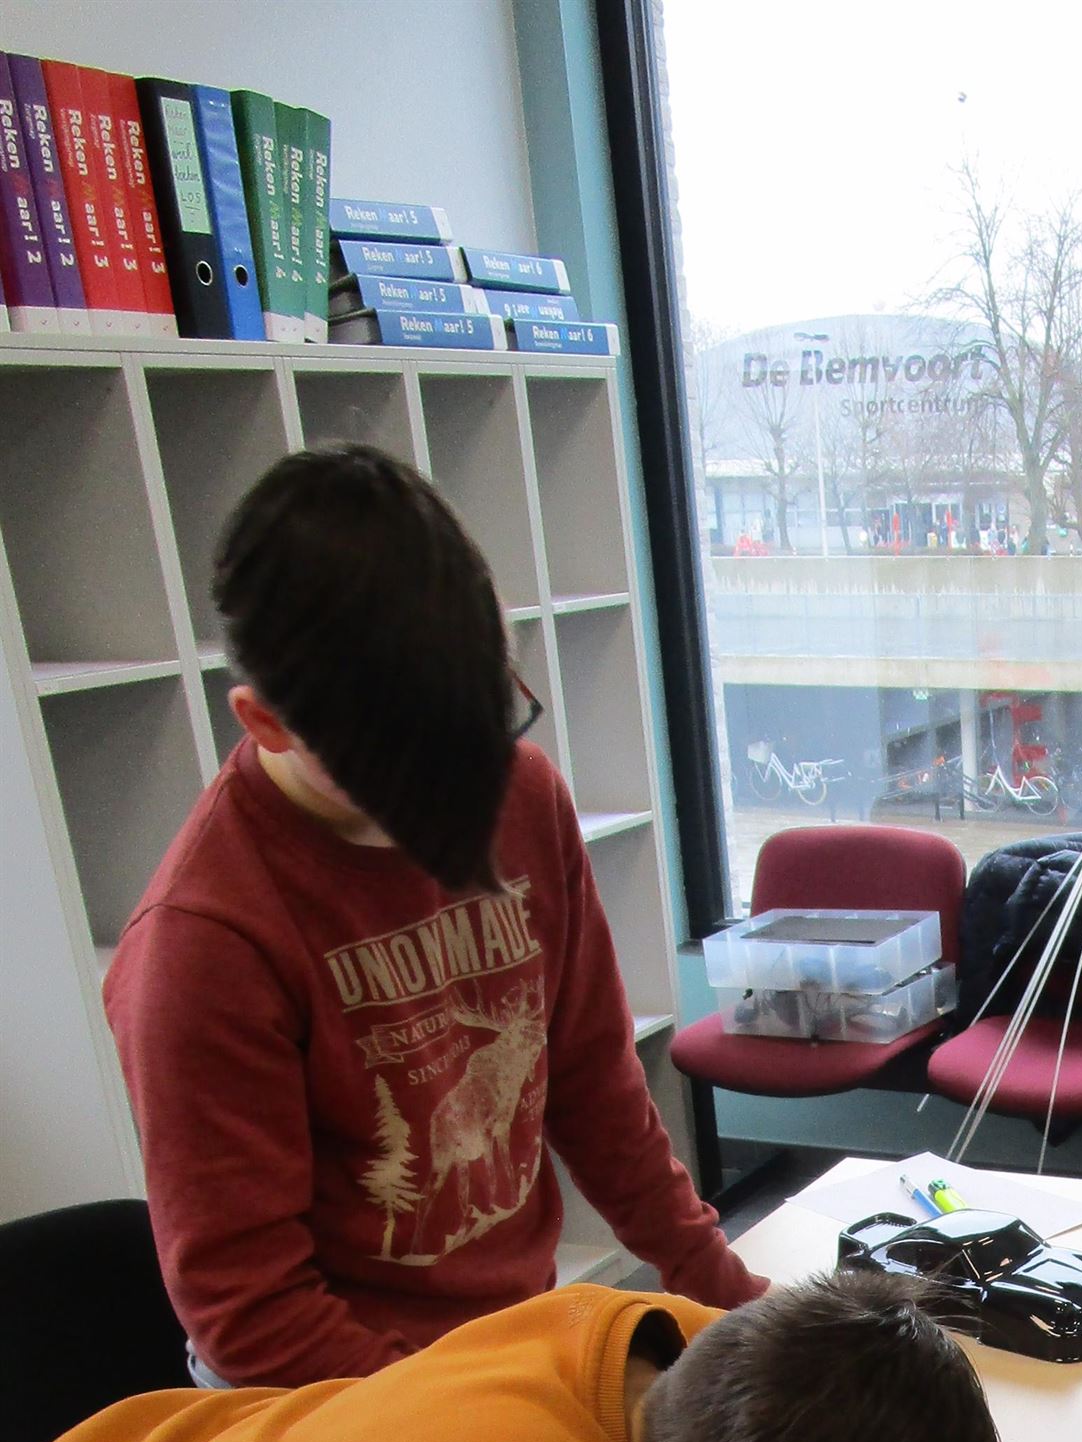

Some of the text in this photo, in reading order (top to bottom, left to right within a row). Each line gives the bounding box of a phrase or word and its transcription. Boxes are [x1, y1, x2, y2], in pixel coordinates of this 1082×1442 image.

[0, 99, 21, 169] Reken
[28, 250, 42, 265] 2
[33, 103, 54, 173] Reken
[60, 252, 75, 267] 2
[68, 108, 88, 176] Reken
[94, 255, 109, 269] 3
[98, 114, 117, 181] Reken
[123, 257, 138, 272] 3
[262, 135, 275, 197] Reken
[291, 146, 303, 205] Reken
[316, 151, 328, 208] Reken
[127, 120, 146, 185] Reken
[152, 261, 167, 275] 3
[345, 206, 379, 222] Reken
[410, 210, 418, 224] 5
[362, 246, 395, 263] Reken
[426, 250, 434, 265] 5
[483, 255, 511, 271] Reken
[379, 283, 410, 300] Reken
[438, 288, 446, 302] 5
[400, 316, 433, 334] Reken
[466, 320, 474, 335] 5
[532, 325, 560, 341] Reken
[742, 348, 986, 388] De Bemvoort
